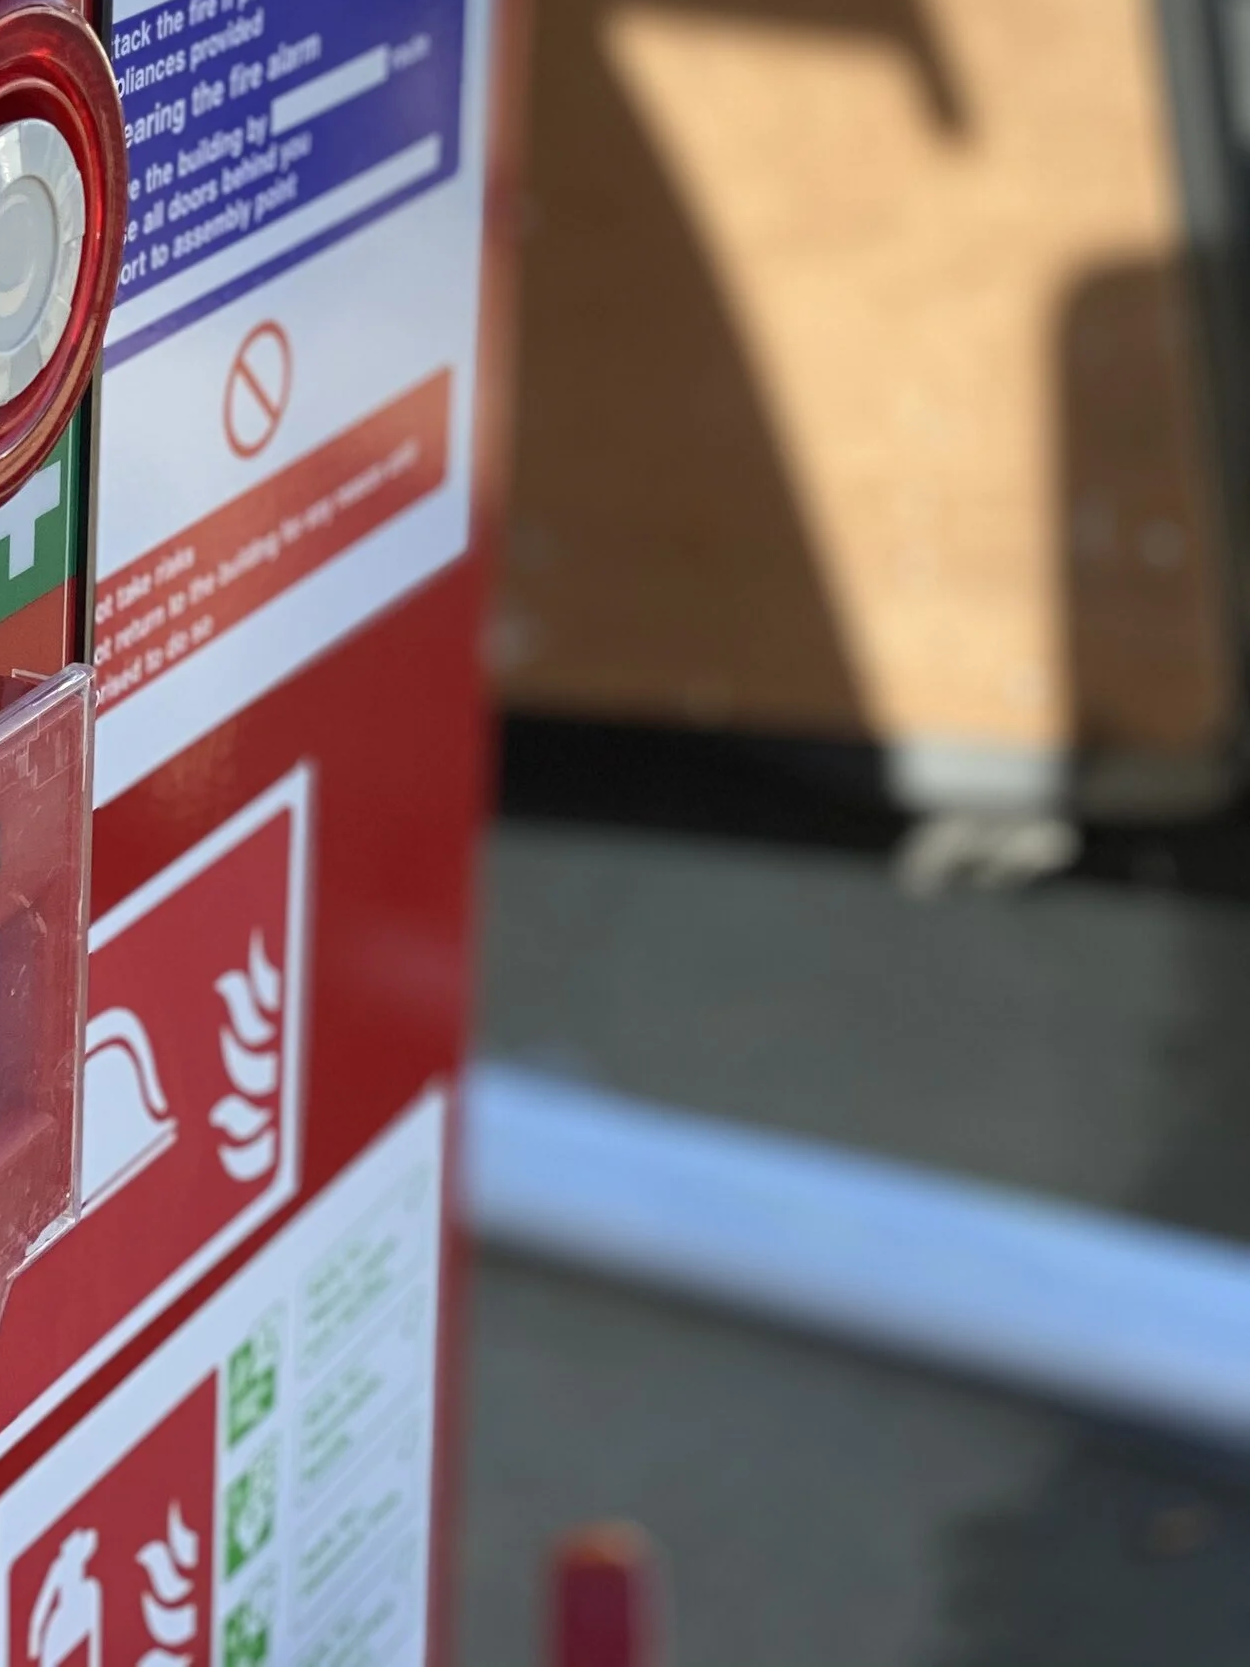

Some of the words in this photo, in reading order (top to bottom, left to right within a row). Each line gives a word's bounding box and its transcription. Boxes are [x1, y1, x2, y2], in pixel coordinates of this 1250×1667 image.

[112, 19, 152, 61] tack
[156, 10, 185, 41] the
[116, 49, 186, 100] pliances
[189, 6, 265, 73] provided
[124, 98, 187, 148] earing
[191, 80, 226, 117] the
[229, 61, 264, 99] fire
[145, 162, 174, 194] the
[177, 126, 244, 178] building
[142, 199, 165, 235] all
[167, 178, 219, 222] doors
[151, 242, 170, 272] to
[172, 197, 253, 259] assembly
